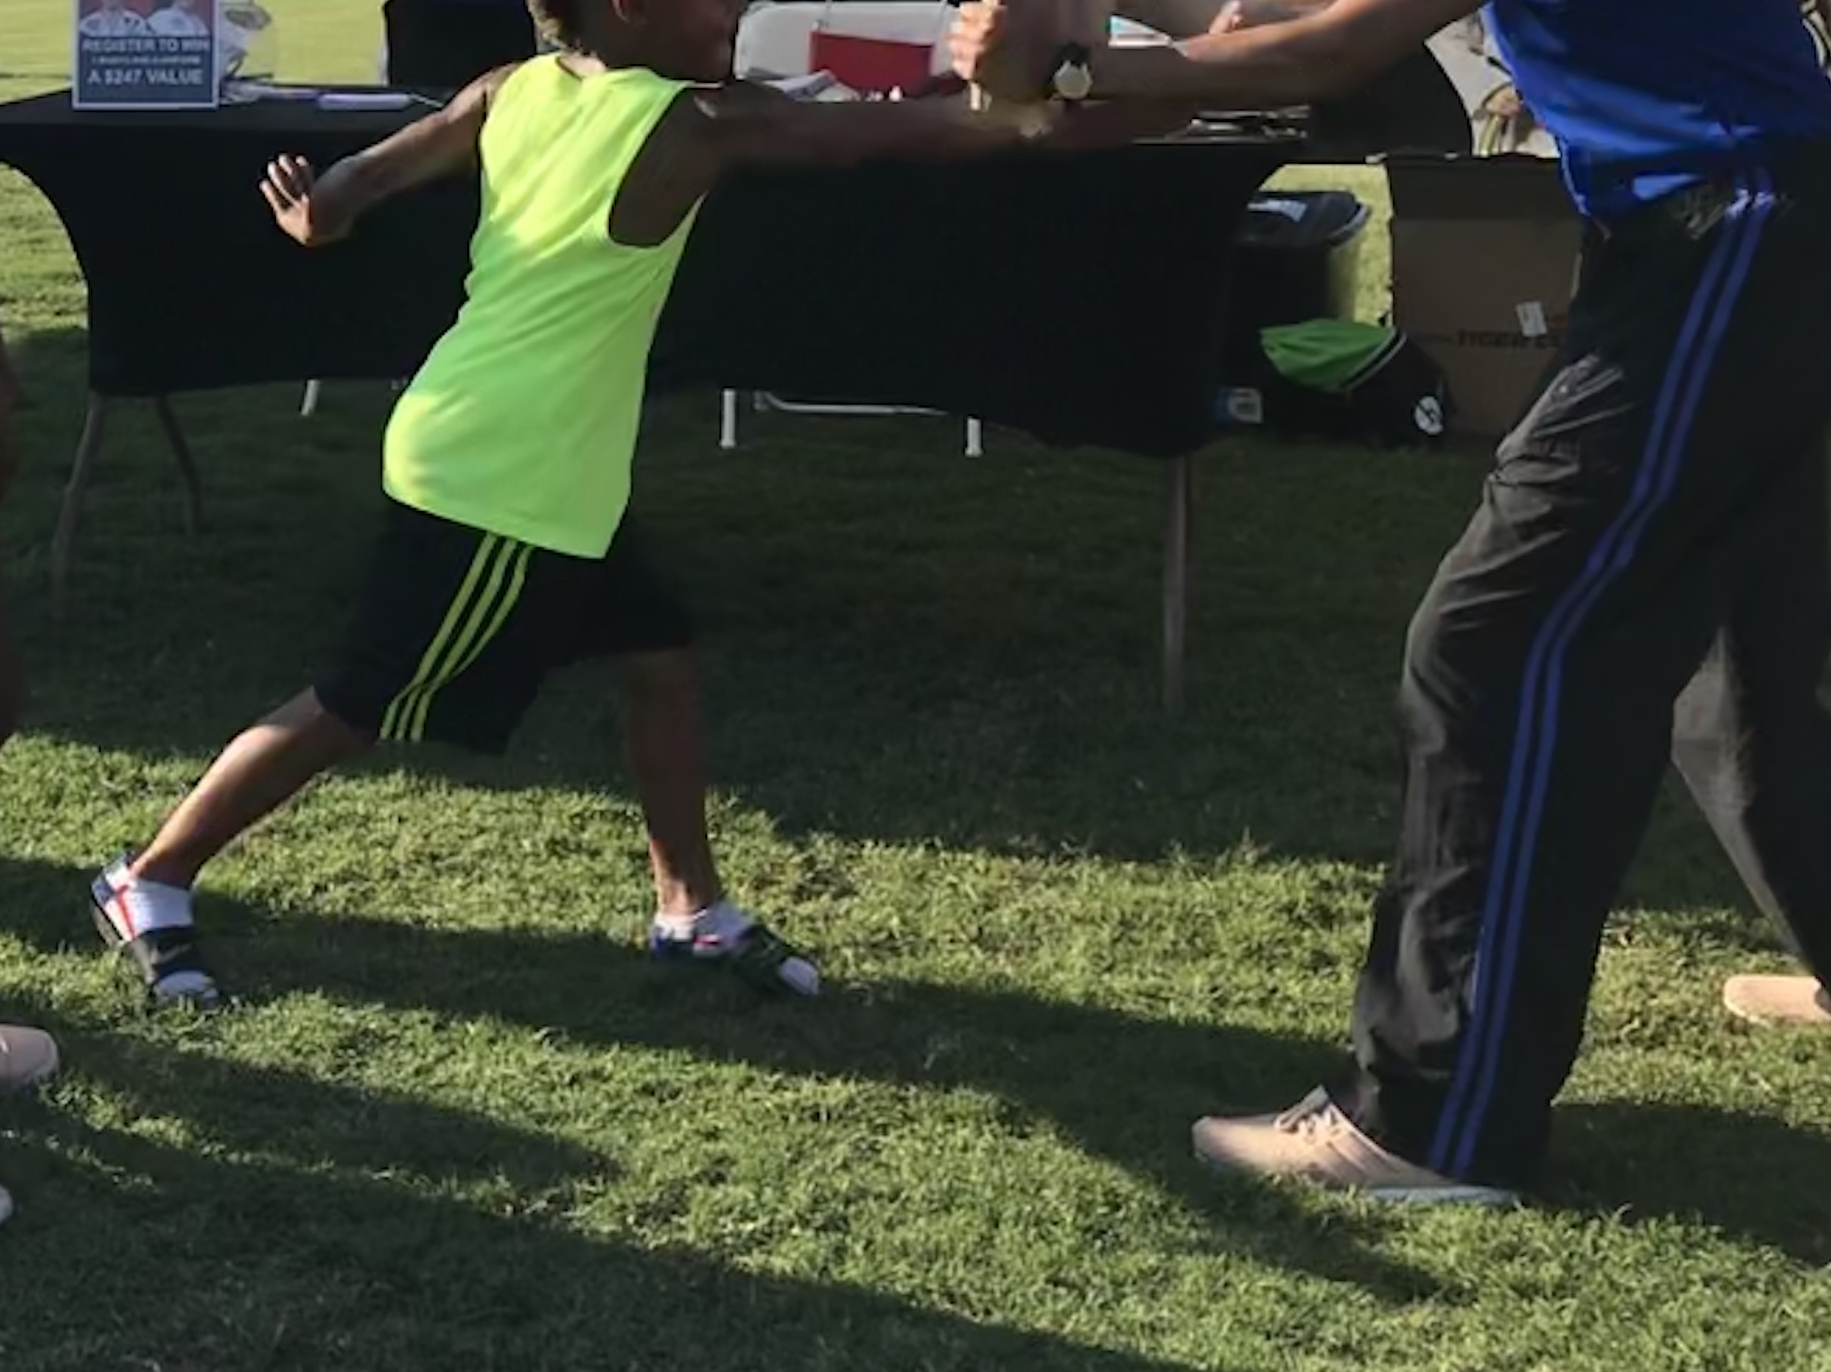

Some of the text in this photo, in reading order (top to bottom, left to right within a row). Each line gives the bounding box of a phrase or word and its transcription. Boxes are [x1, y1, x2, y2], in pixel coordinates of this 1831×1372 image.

[81, 38, 210, 52] REGISTER TO WIN
[87, 69, 204, 85] A $247 VALUE
